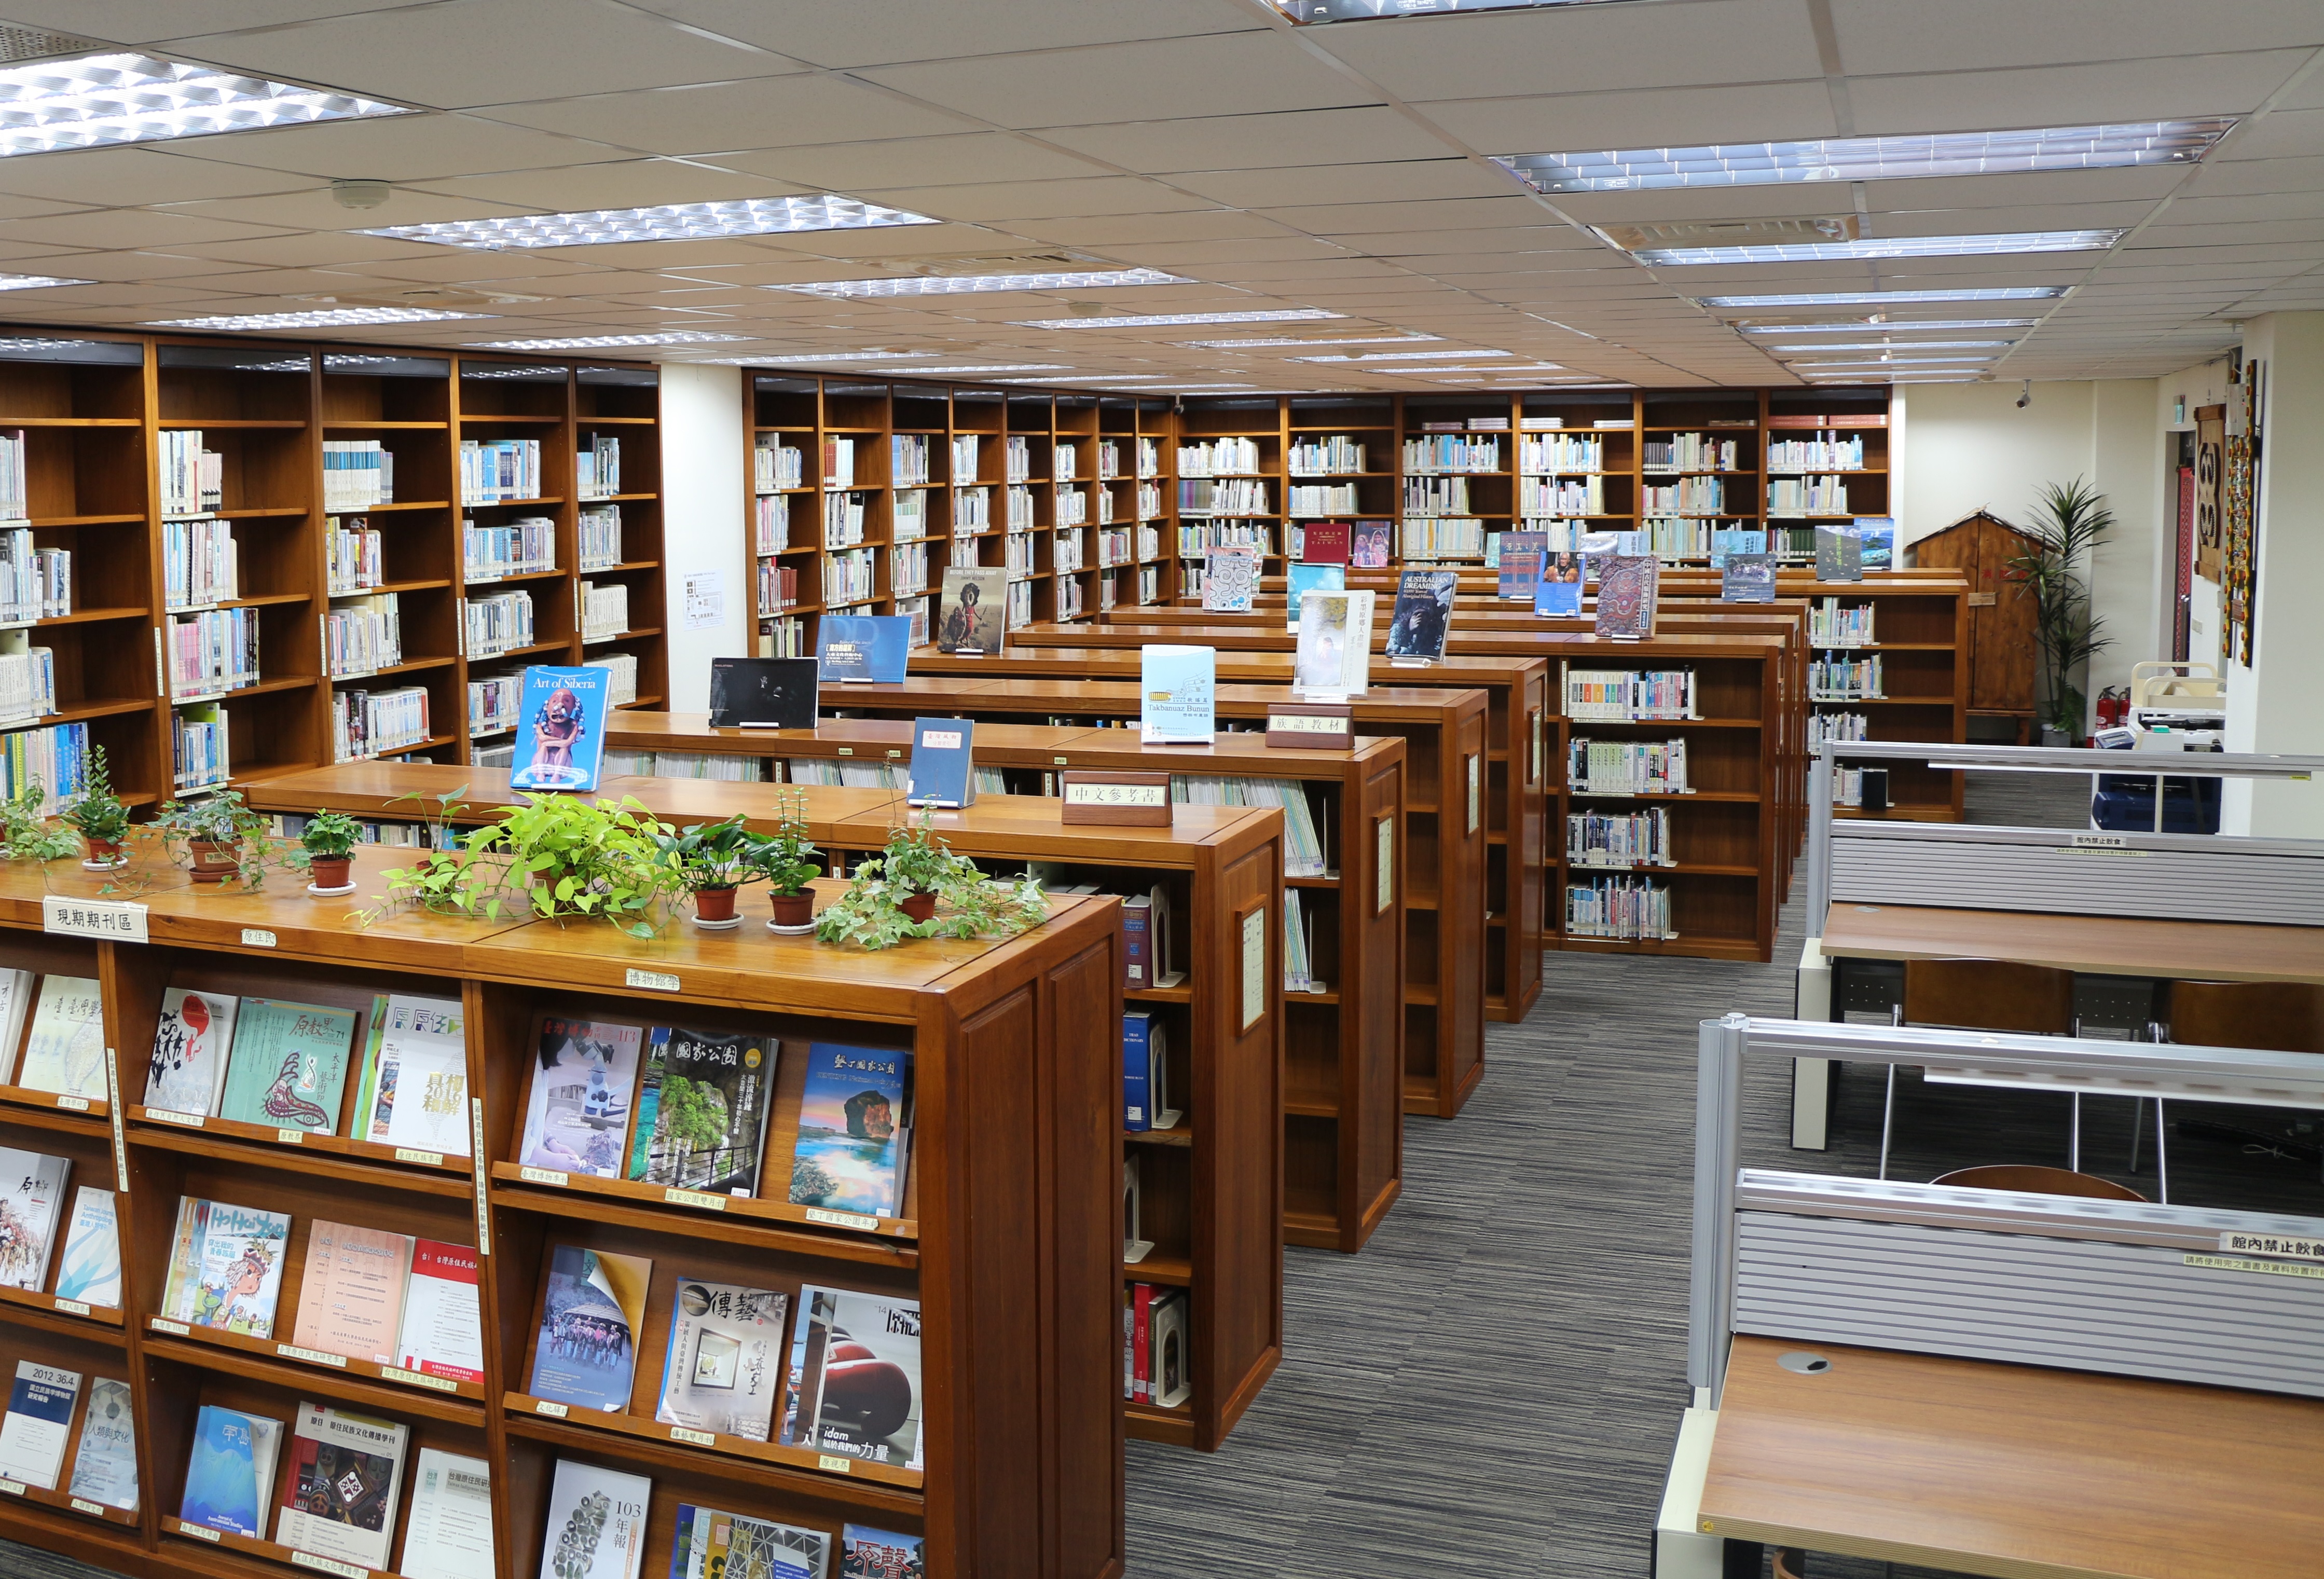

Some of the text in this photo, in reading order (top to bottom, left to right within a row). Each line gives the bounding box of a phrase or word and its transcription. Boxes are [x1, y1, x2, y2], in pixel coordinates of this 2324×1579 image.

[533, 677, 596, 689] Art of Siberia
[1276, 718, 1340, 731] 族語教材
[1076, 787, 1156, 803] 中文參考書
[2077, 837, 2121, 845] 館內禁止飲食
[57, 909, 132, 930] 現期期刊區
[244, 930, 274, 944] 原住民
[629, 972, 678, 989] 博物館學
[288, 1014, 334, 1037] 原教界
[336, 1031, 345, 1039] 71
[618, 1029, 636, 1042] 113
[676, 1041, 738, 1065] 國家公園
[328, 1052, 341, 1083] 太平洋
[834, 1053, 896, 1075] 墾丁國家公園
[317, 1071, 329, 1102] 藝術節
[281, 1131, 300, 1141] 原教界
[397, 1151, 442, 1164] 原住民族季刊
[521, 1170, 567, 1184] 臺灣博物季刊
[667, 1191, 725, 1208] 國家公園雙月刊
[2232, 1236, 2324, 1256] 館內禁止飲食
[710, 1290, 758, 1322] 傳藝
[877, 1306, 887, 1314] 14
[172, 1323, 188, 1334] YOUNG
[33, 1368, 53, 1381] 2012
[384, 1368, 456, 1391] 台灣原住民族研究學報
[538, 1403, 567, 1416] 文化驛站
[88, 1423, 130, 1444] 人類與文化
[222, 1424, 251, 1446] 南島
[329, 1421, 396, 1445] 原住民族文化傳播學刊
[671, 1430, 713, 1445] 傳藝雙月刊
[824, 1426, 849, 1440] idam
[822, 1438, 889, 1462] 屬於我們的力量
[820, 1459, 848, 1470] 原視界
[73, 1501, 103, 1514] 人類與文化
[615, 1501, 641, 1518] 103
[182, 1523, 220, 1540] 南島研究學報
[613, 1518, 628, 1549] 年報
[294, 1551, 368, 1579] 原住民族文化傳播學刊
